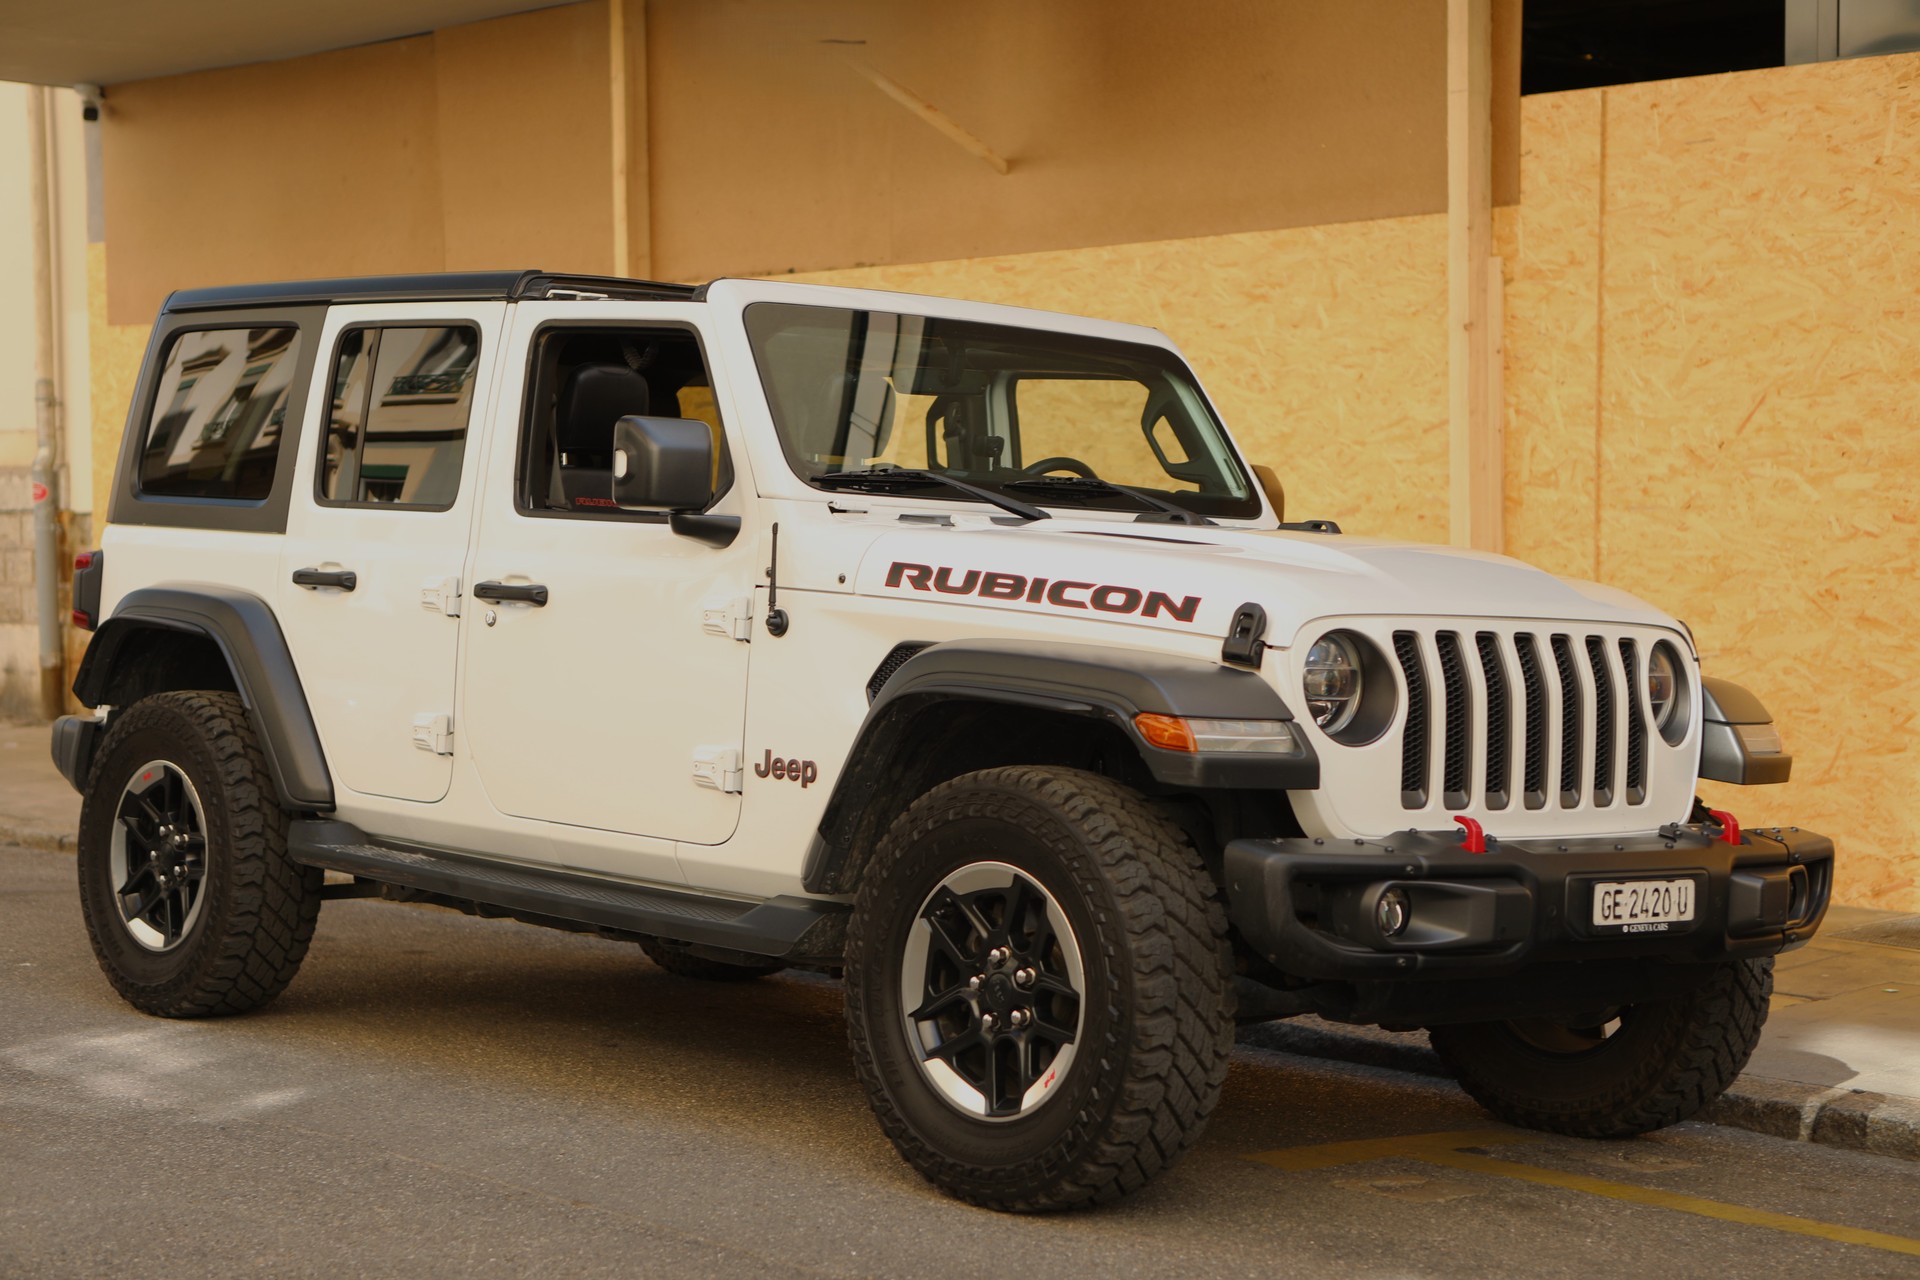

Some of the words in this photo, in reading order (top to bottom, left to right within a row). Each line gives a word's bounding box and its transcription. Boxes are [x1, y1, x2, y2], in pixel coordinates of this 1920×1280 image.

[884, 561, 1202, 623] RUBICON
[754, 748, 818, 789] Jeep
[1629, 887, 1671, 918] 2420
[1629, 924, 1653, 932] GENEVA
[1653, 922, 1669, 931] CARS
